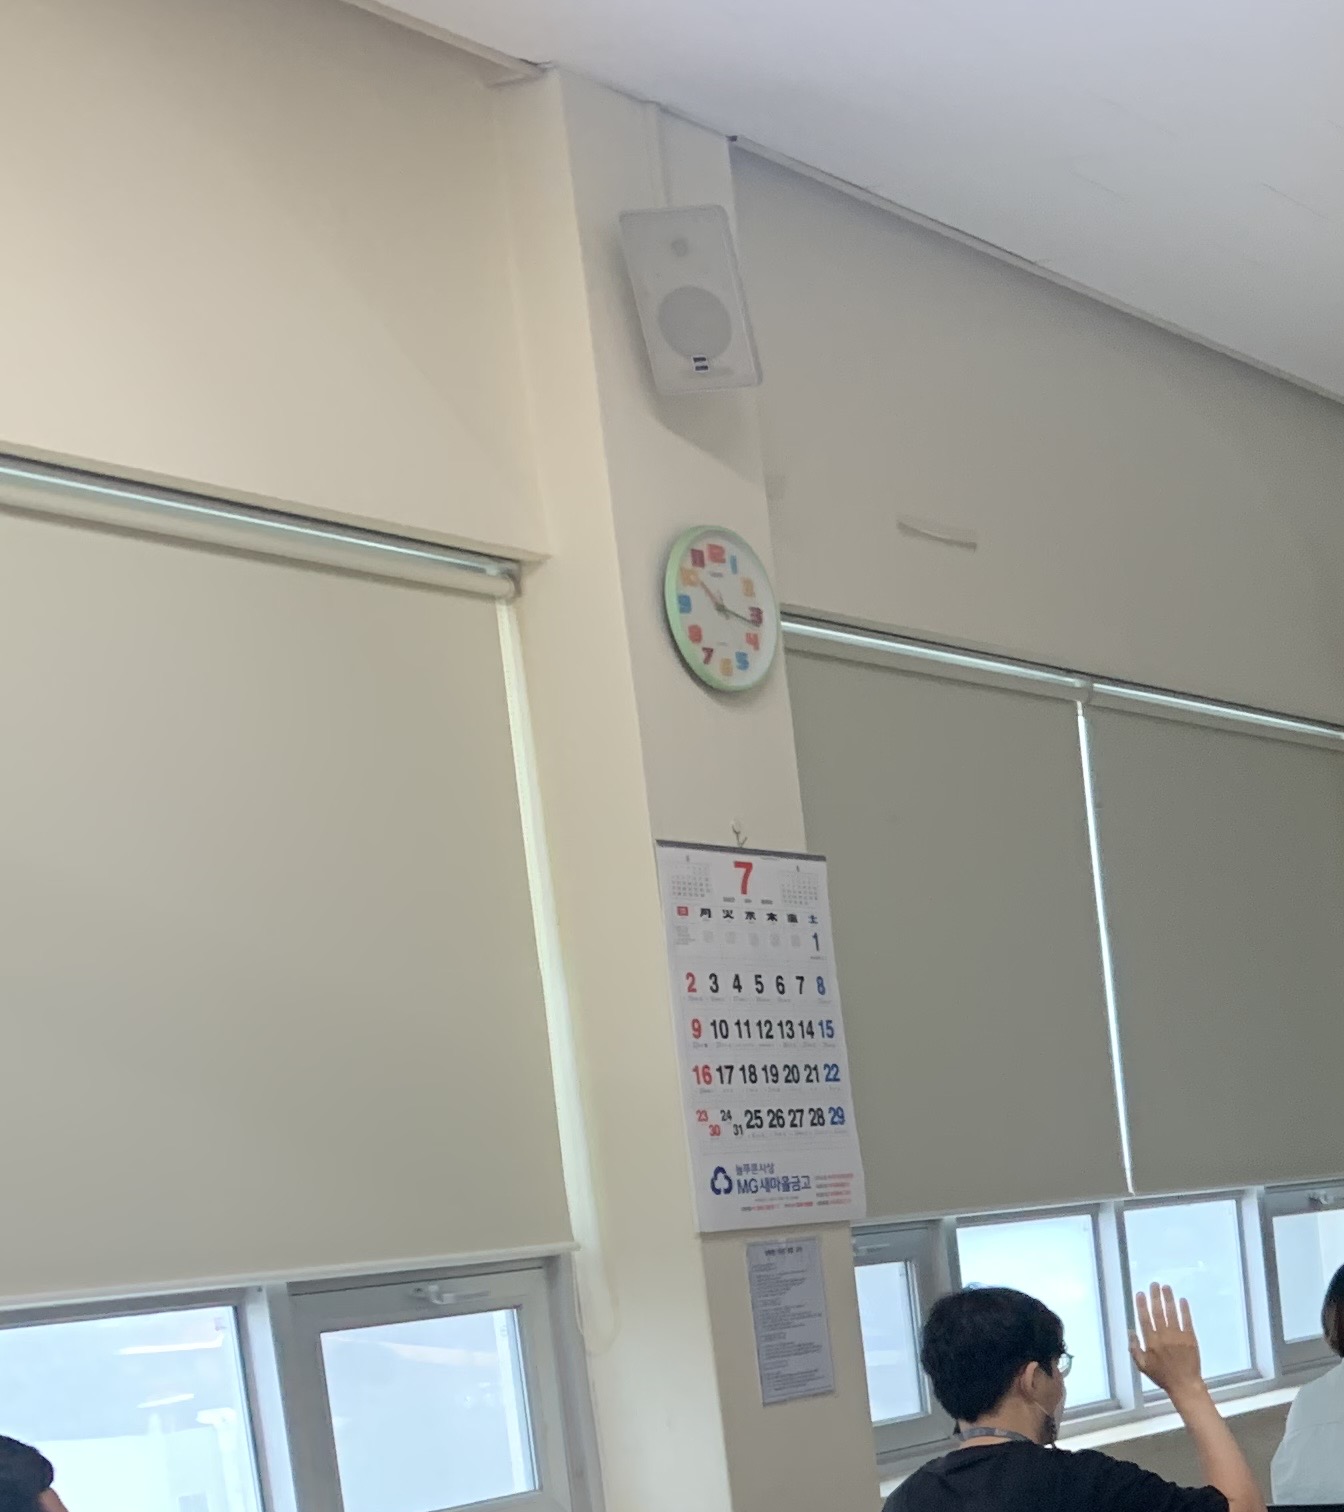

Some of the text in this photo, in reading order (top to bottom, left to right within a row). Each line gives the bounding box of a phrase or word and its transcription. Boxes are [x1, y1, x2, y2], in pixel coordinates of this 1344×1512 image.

[746, 632, 759, 651] 4
[702, 647, 714, 664] 7
[735, 652, 749, 670] 5
[733, 861, 754, 895] 7
[677, 906, 689, 917] 日
[808, 914, 818, 924] 土
[812, 932, 820, 952] 1
[685, 972, 697, 993] 2
[708, 972, 720, 993] 3
[732, 974, 743, 994] 4
[754, 974, 764, 994] 5
[775, 975, 786, 995] 6
[796, 976, 805, 994] 7
[816, 976, 826, 996] 8
[691, 1018, 835, 1040] 9 10 11 12 13 14 15
[692, 1064, 841, 1086] 16 17 18 19 20 21 22
[696, 1106, 846, 1129] 23 24 25 26 27 28 29
[708, 1124, 744, 1137] 30 31
[737, 1178, 759, 1194] MG
[760, 1175, 812, 1192] 새마을금고
